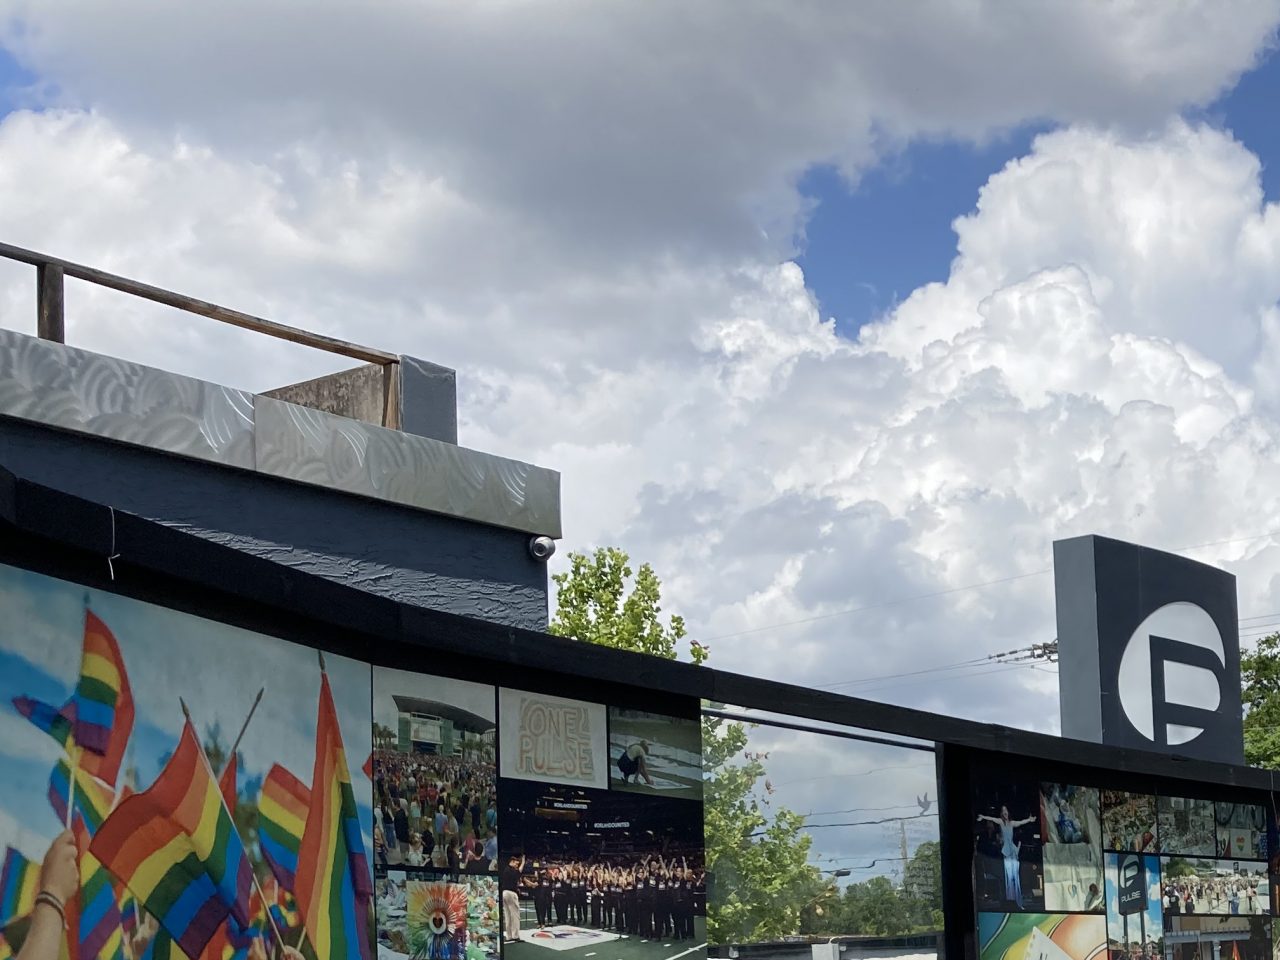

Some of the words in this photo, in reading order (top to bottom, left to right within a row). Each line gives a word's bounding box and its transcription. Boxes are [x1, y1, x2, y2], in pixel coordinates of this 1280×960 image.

[527, 703, 578, 741] ONE
[518, 735, 593, 776] PULSE
[1121, 890, 1141, 903] PULSE
